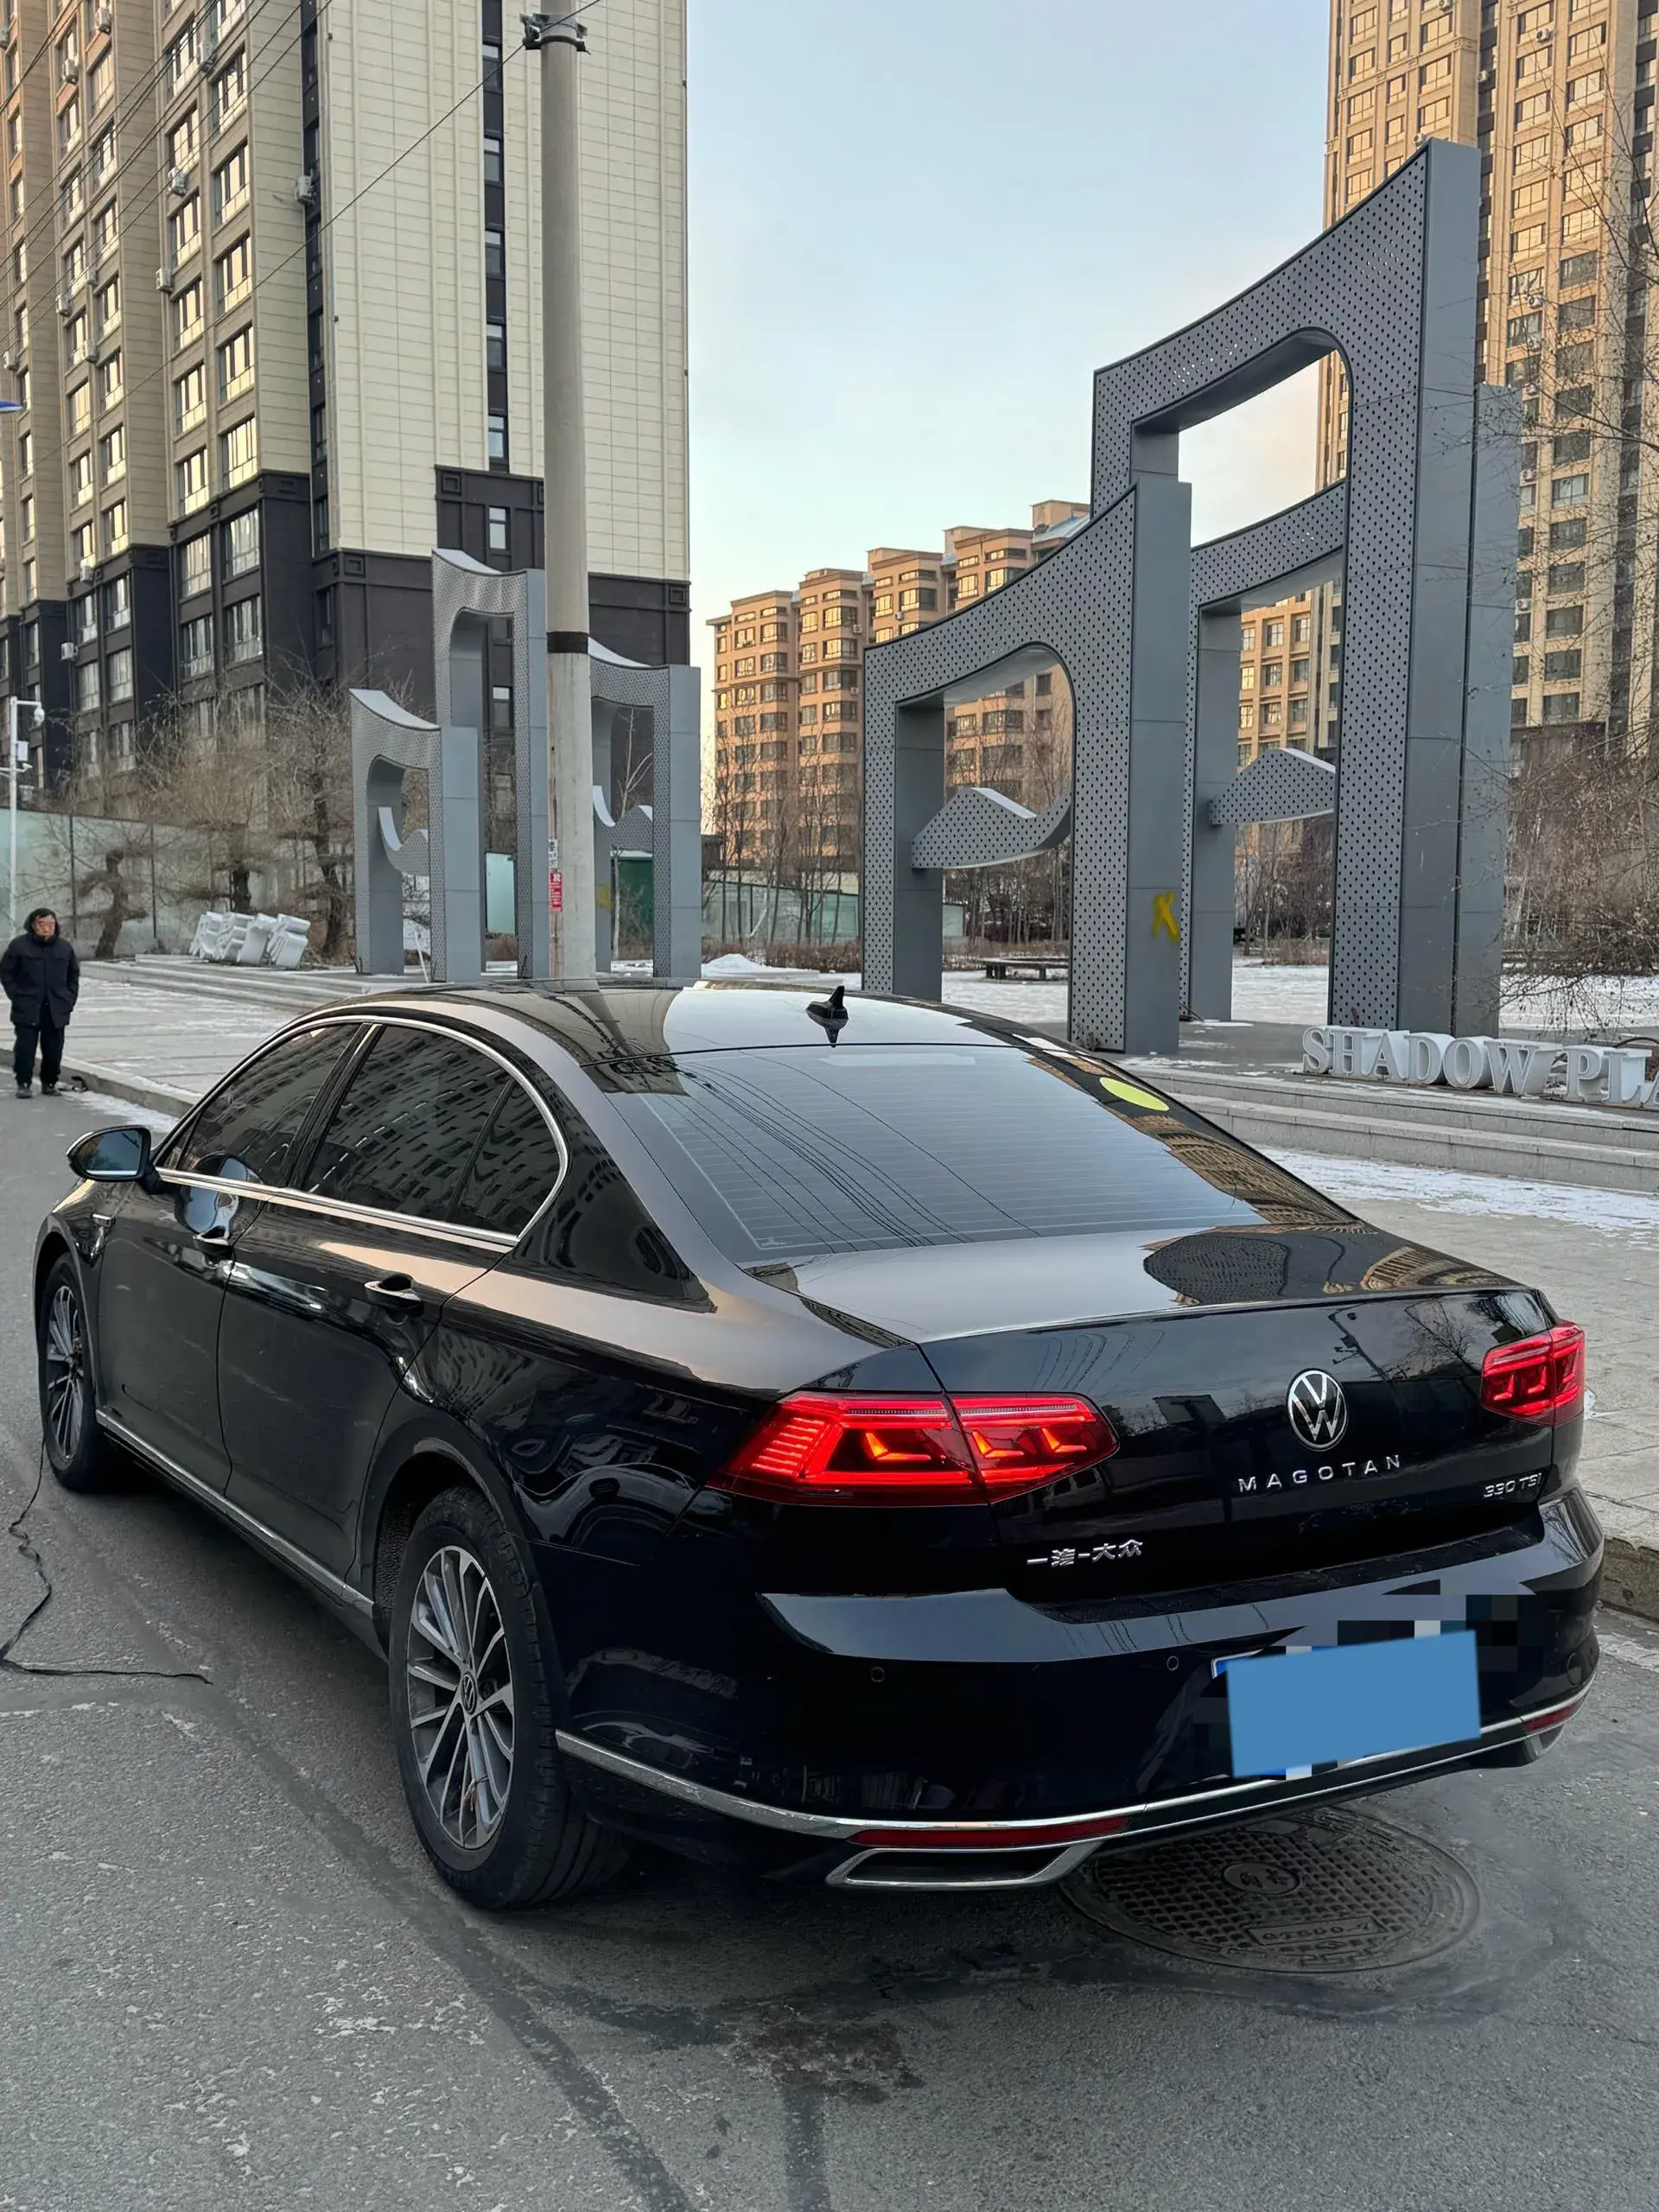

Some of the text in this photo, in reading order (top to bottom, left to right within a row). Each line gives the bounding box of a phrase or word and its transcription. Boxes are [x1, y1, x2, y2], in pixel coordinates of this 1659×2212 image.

[1302, 1026, 1560, 1096] SHADOW
[1236, 1454, 1402, 1493] MAGOTAN
[1483, 1472, 1542, 1498] 330 TSI
